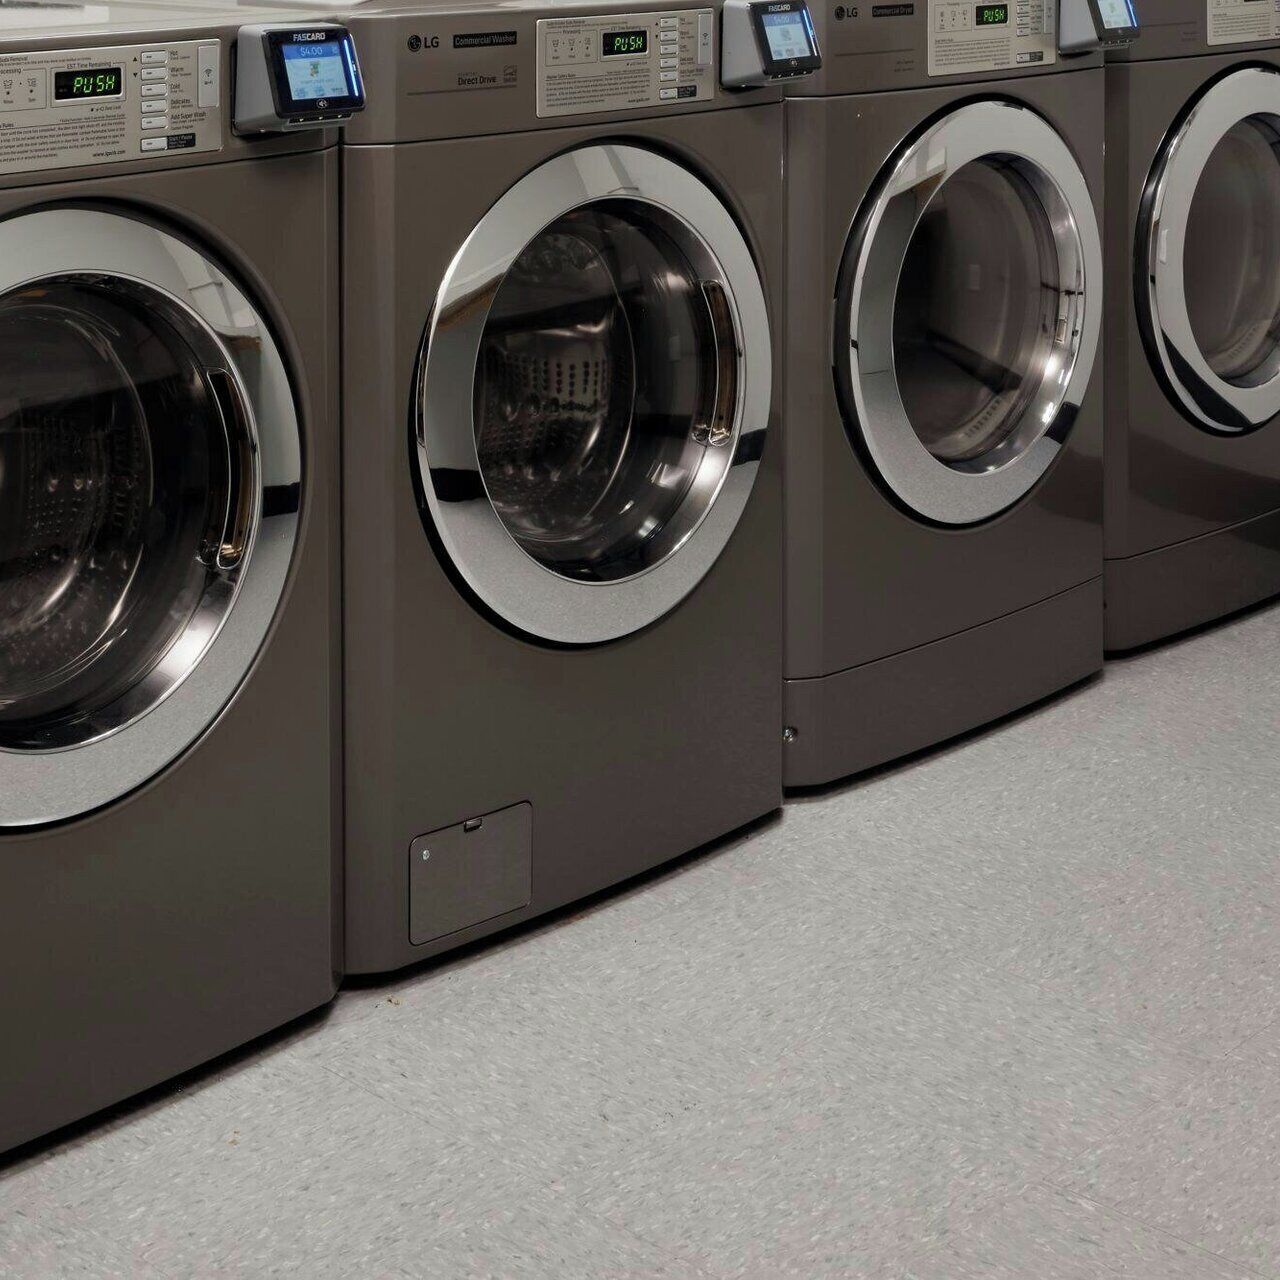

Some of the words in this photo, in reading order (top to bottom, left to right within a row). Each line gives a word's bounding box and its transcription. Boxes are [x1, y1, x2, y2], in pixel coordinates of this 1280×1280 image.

[846, 7, 858, 18] LG
[983, 9, 1005, 22] PUSH
[293, 32, 326, 41] FASCARD
[424, 36, 439, 48] LG
[614, 36, 643, 51] PUSH
[73, 75, 115, 93] PUSH
